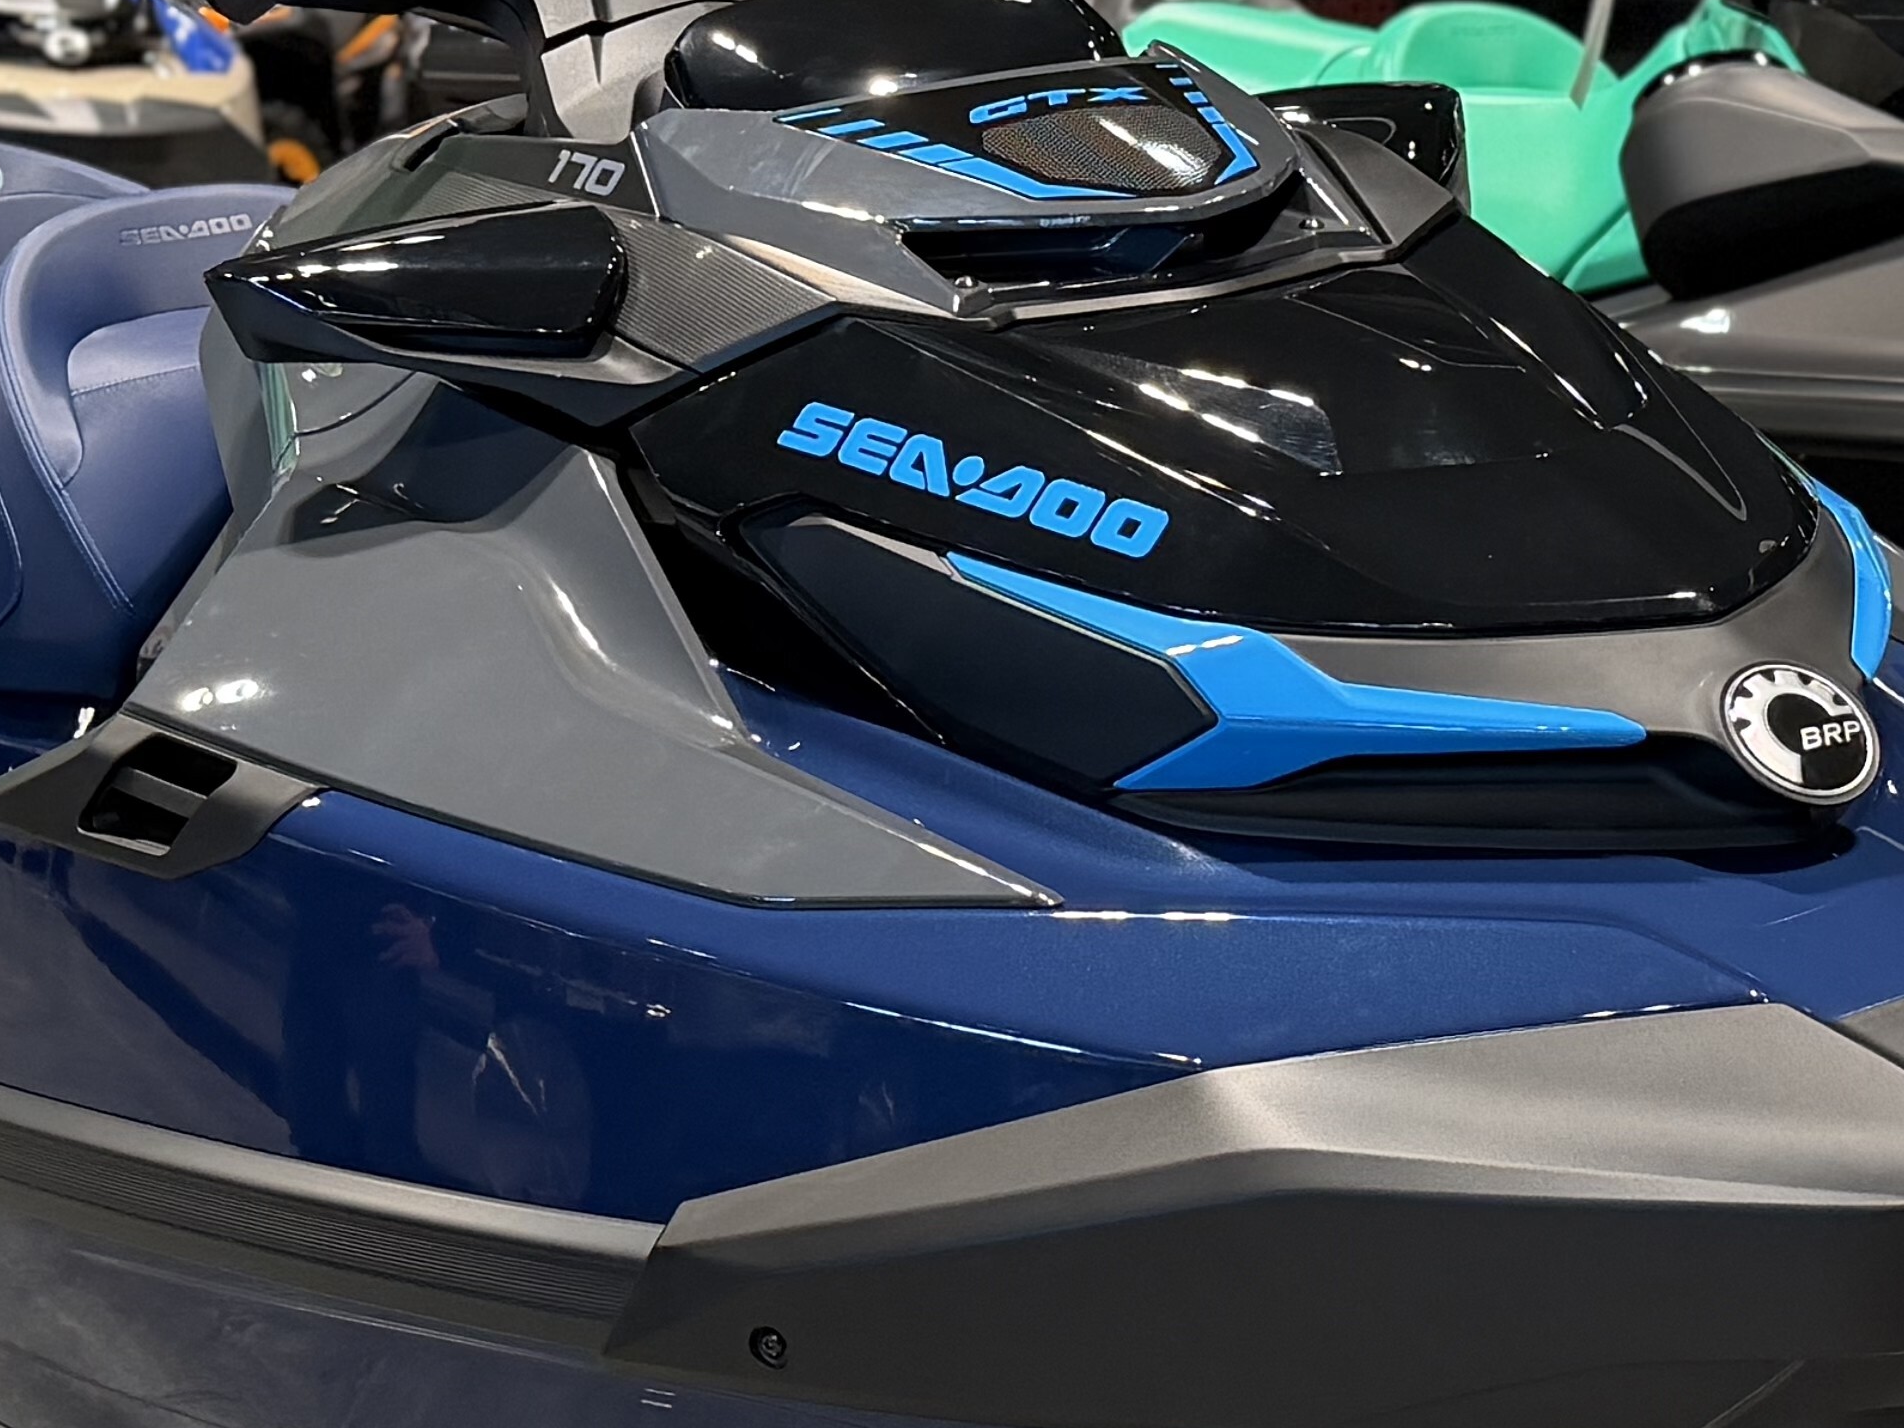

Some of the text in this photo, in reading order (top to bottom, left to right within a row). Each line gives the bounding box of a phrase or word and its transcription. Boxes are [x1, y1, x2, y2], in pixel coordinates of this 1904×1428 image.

[969, 87, 1149, 124] GTX
[547, 149, 625, 196] 170
[1800, 720, 1862, 751] BRP
